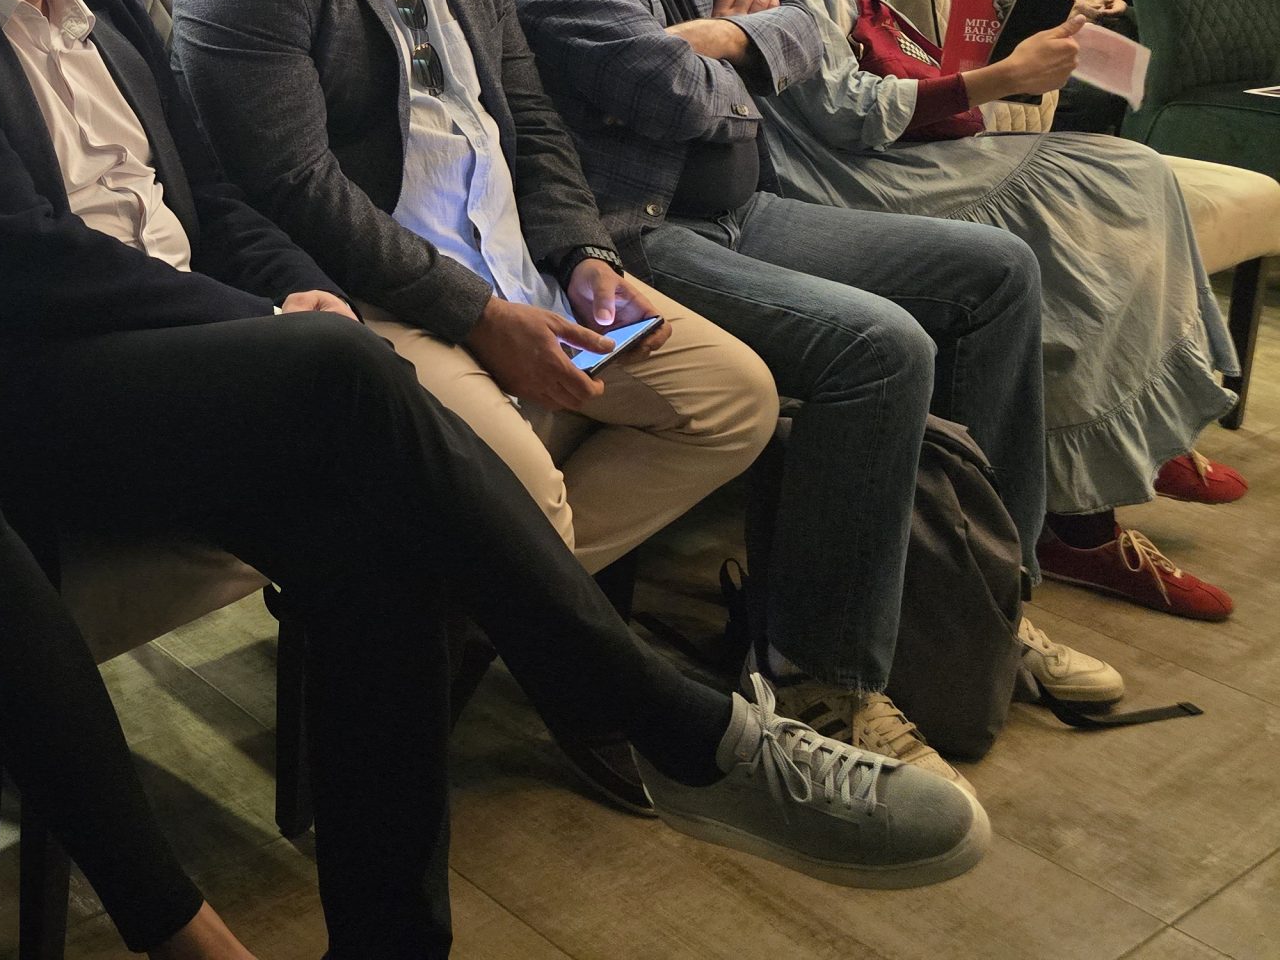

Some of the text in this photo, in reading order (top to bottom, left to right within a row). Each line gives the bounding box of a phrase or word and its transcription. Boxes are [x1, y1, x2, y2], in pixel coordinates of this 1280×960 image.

[965, 18, 1000, 28] MIT O
[964, 26, 996, 36] BALK
